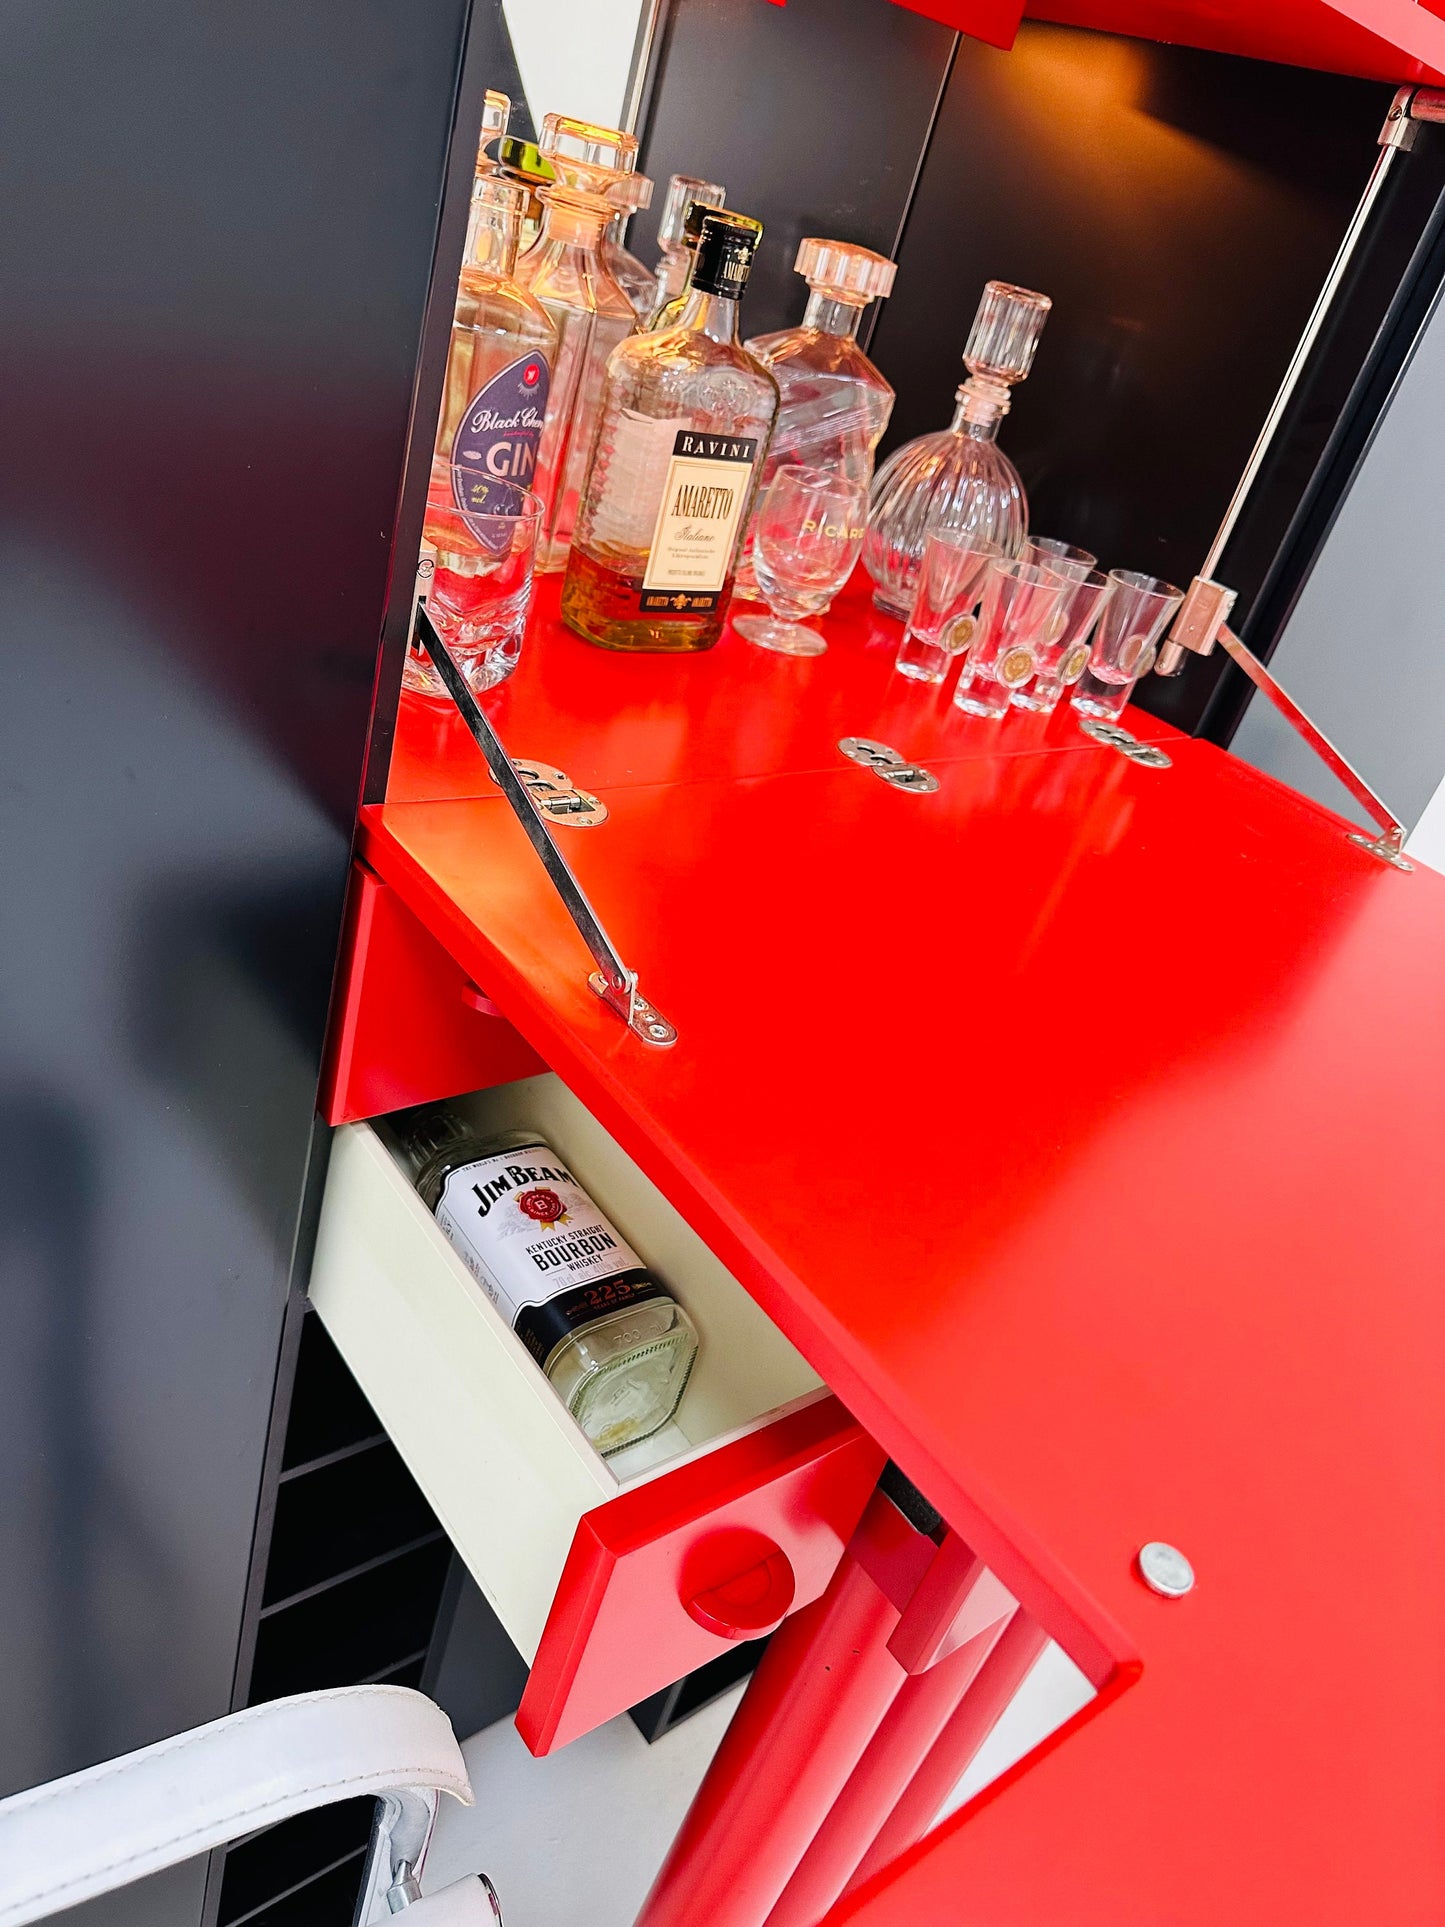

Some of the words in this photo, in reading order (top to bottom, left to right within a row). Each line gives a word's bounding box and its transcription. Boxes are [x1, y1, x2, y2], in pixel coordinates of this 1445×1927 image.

[470, 409, 520, 433] Black
[486, 441, 538, 477] GIN
[682, 435, 750, 459] RAVINI
[671, 484, 734, 520] AMARETTO
[471, 1175, 513, 1218] JIM
[504, 1165, 581, 1188] BEAM
[534, 1199, 549, 1210] B
[525, 1234, 568, 1255] KENTUCKY
[567, 1223, 606, 1241] STRAIGHT
[531, 1231, 618, 1272] BOURBON
[566, 1253, 604, 1272] WHISKEY
[583, 1279, 631, 1306] 225
